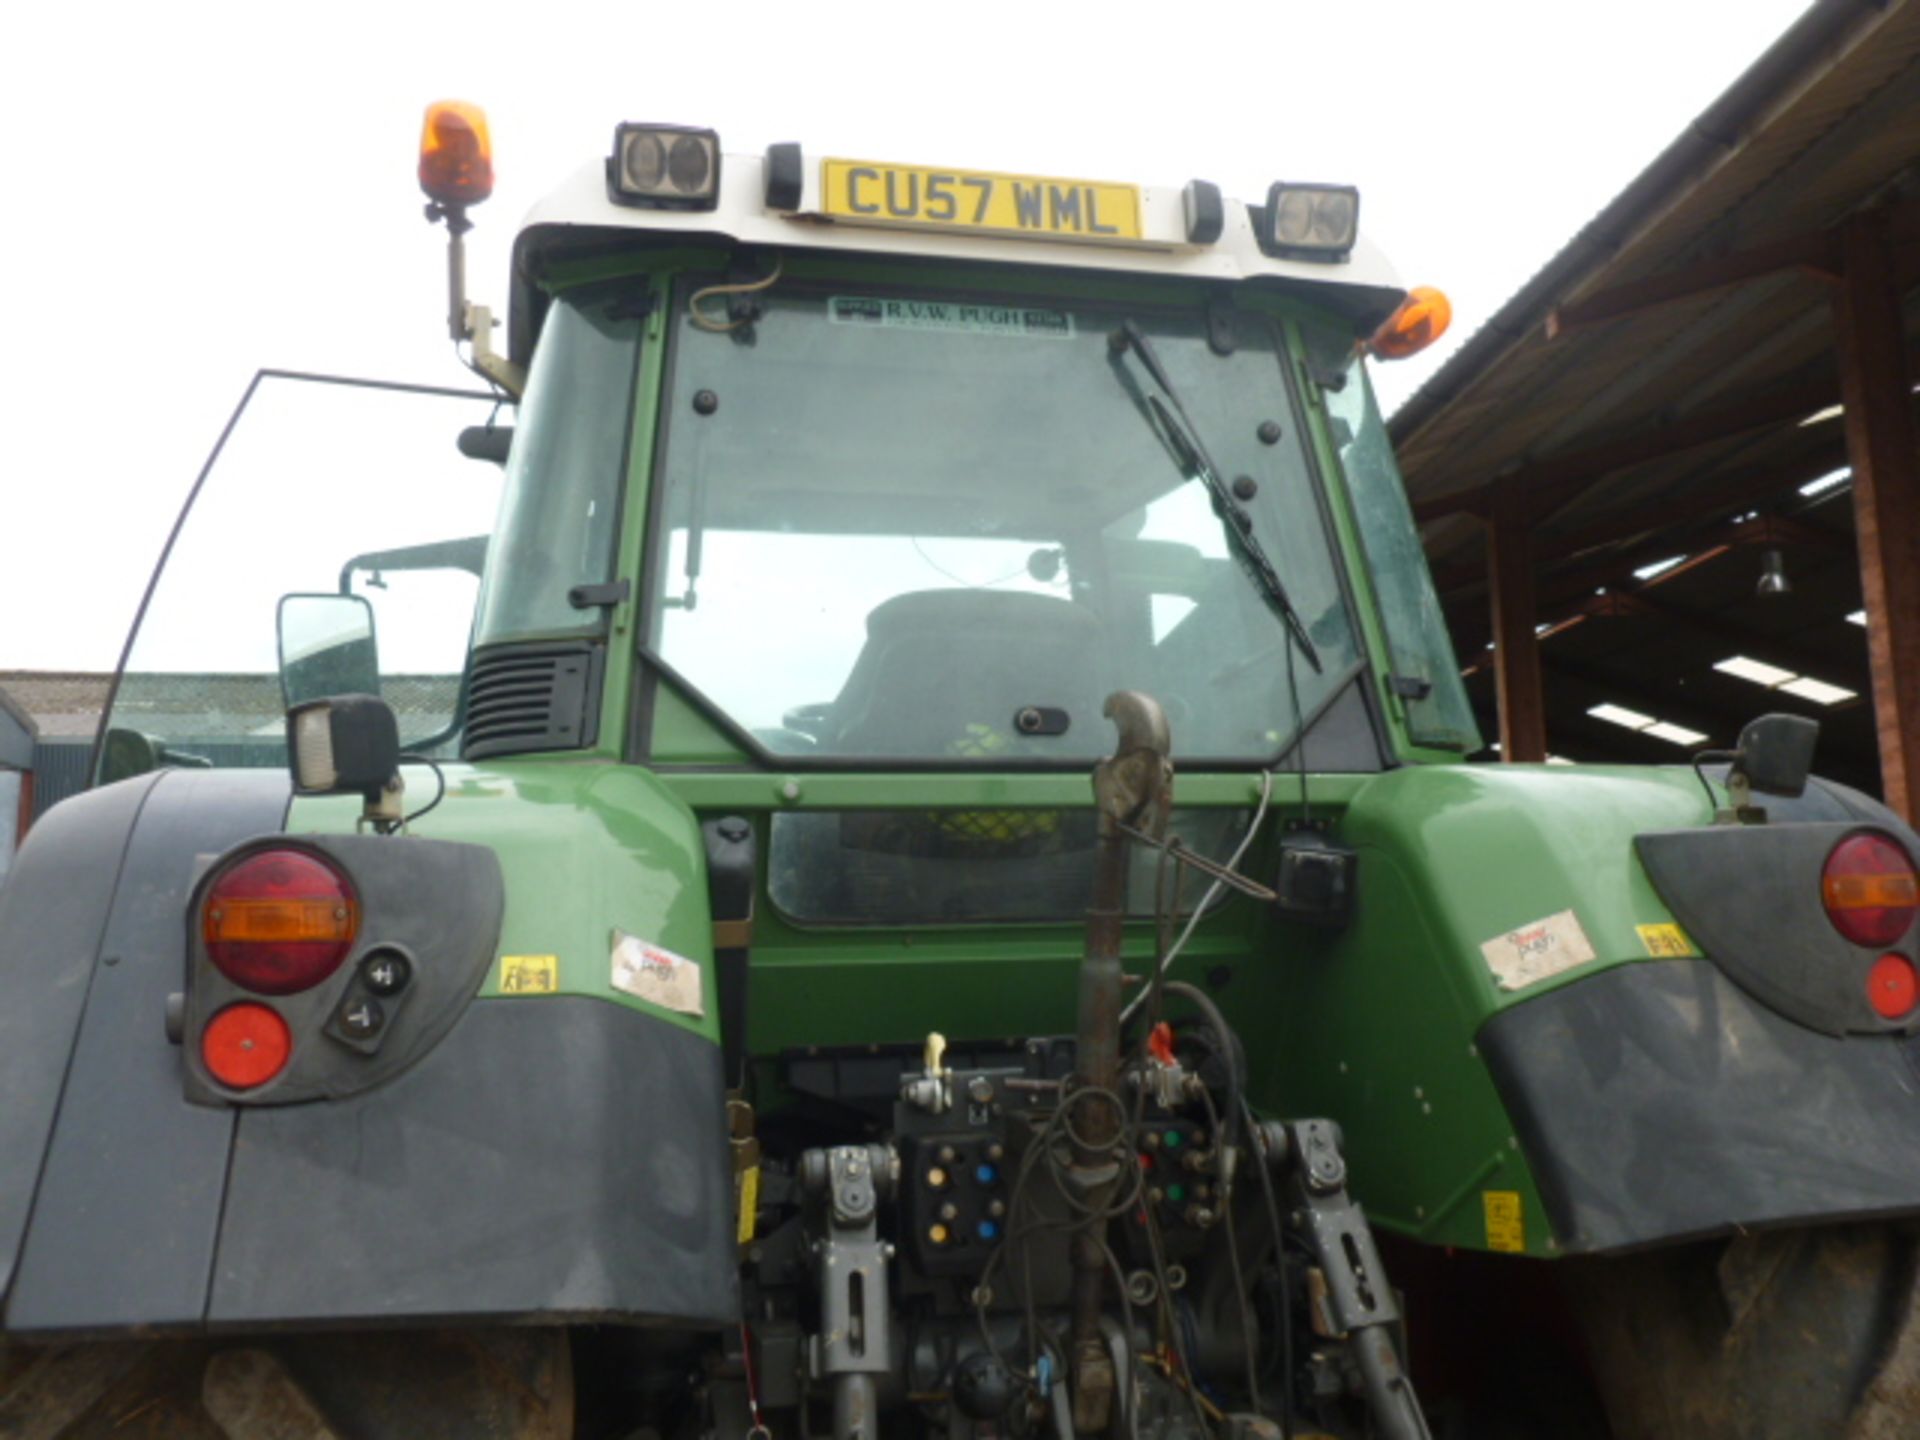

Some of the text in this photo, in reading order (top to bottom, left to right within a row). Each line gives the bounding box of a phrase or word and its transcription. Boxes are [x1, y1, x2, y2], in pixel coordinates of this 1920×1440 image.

[846, 166, 1119, 234] CU57 WML
[887, 302, 951, 322] R.V.W.
[959, 307, 1019, 325] PUGH
